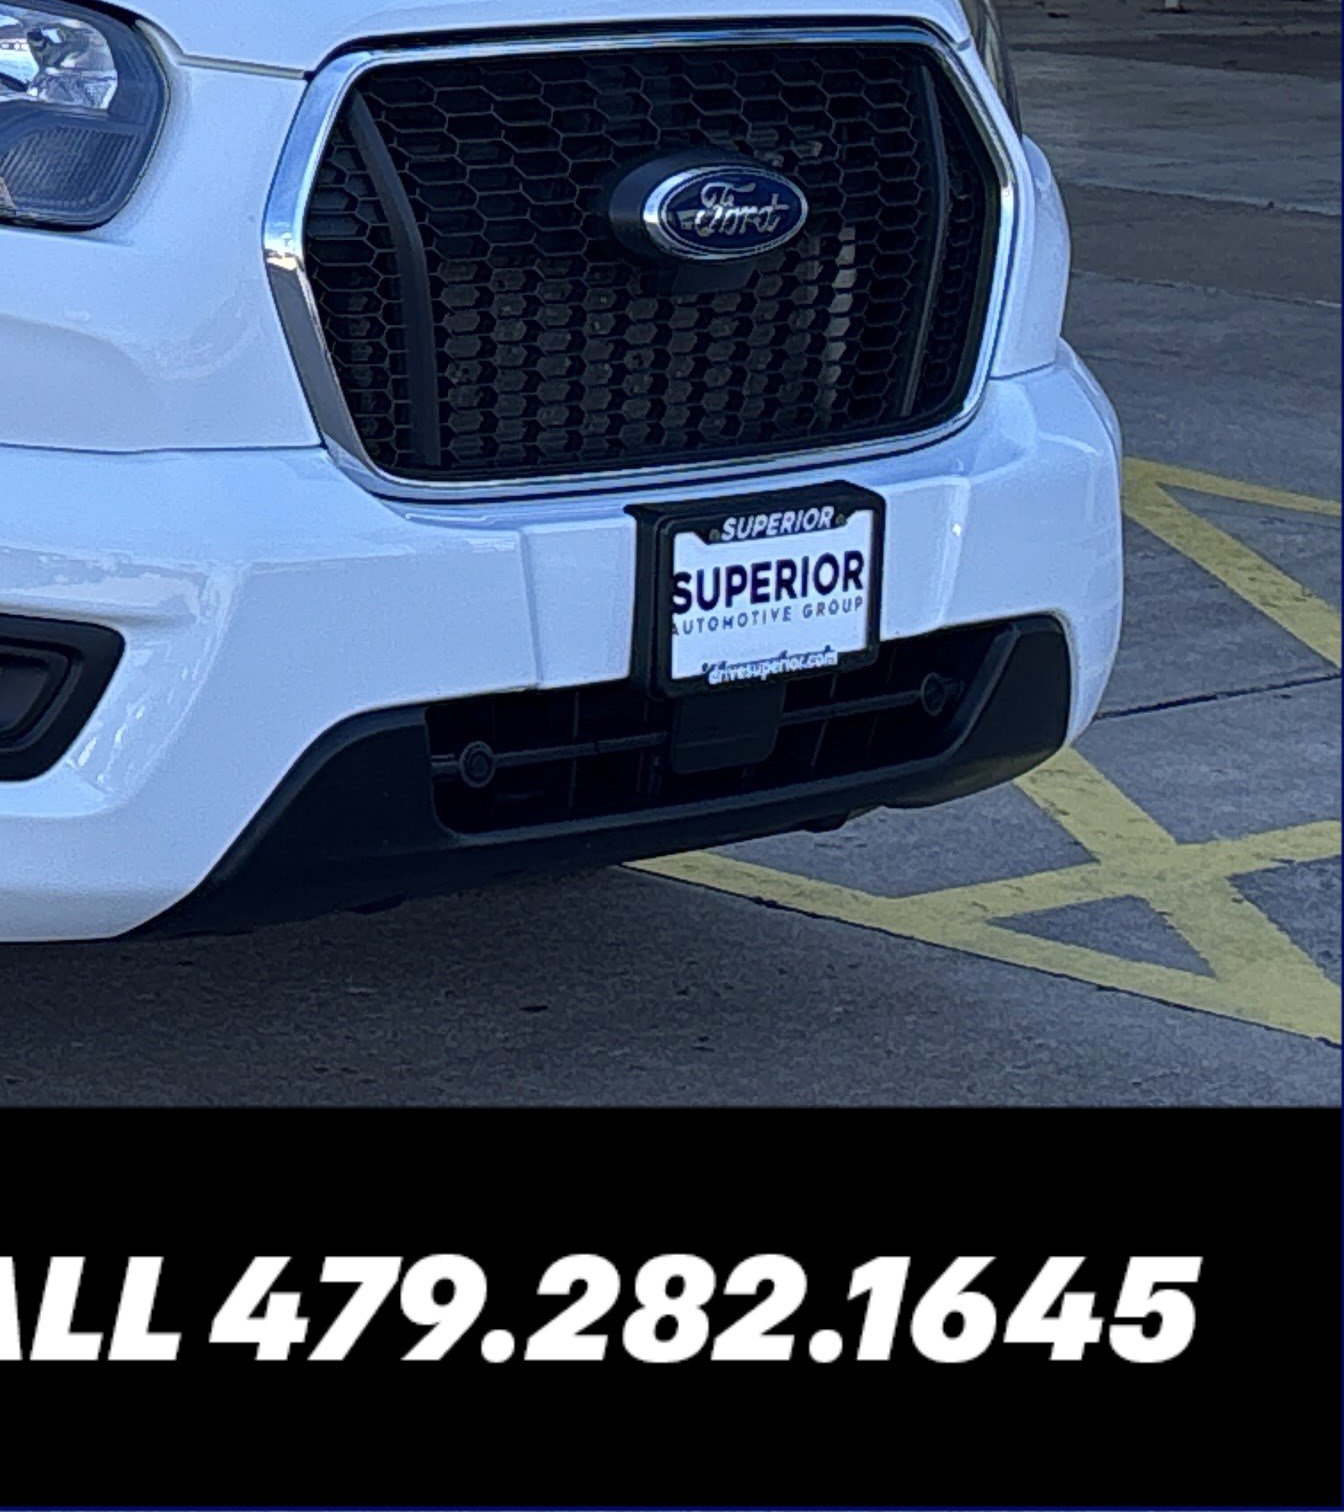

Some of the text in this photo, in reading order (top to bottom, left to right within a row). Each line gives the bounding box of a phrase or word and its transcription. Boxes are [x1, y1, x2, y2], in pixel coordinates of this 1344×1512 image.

[696, 181, 790, 237] Ford
[721, 506, 835, 541] SUPERIOR
[672, 550, 864, 614] SUPERIOR
[802, 595, 864, 620] GROUP
